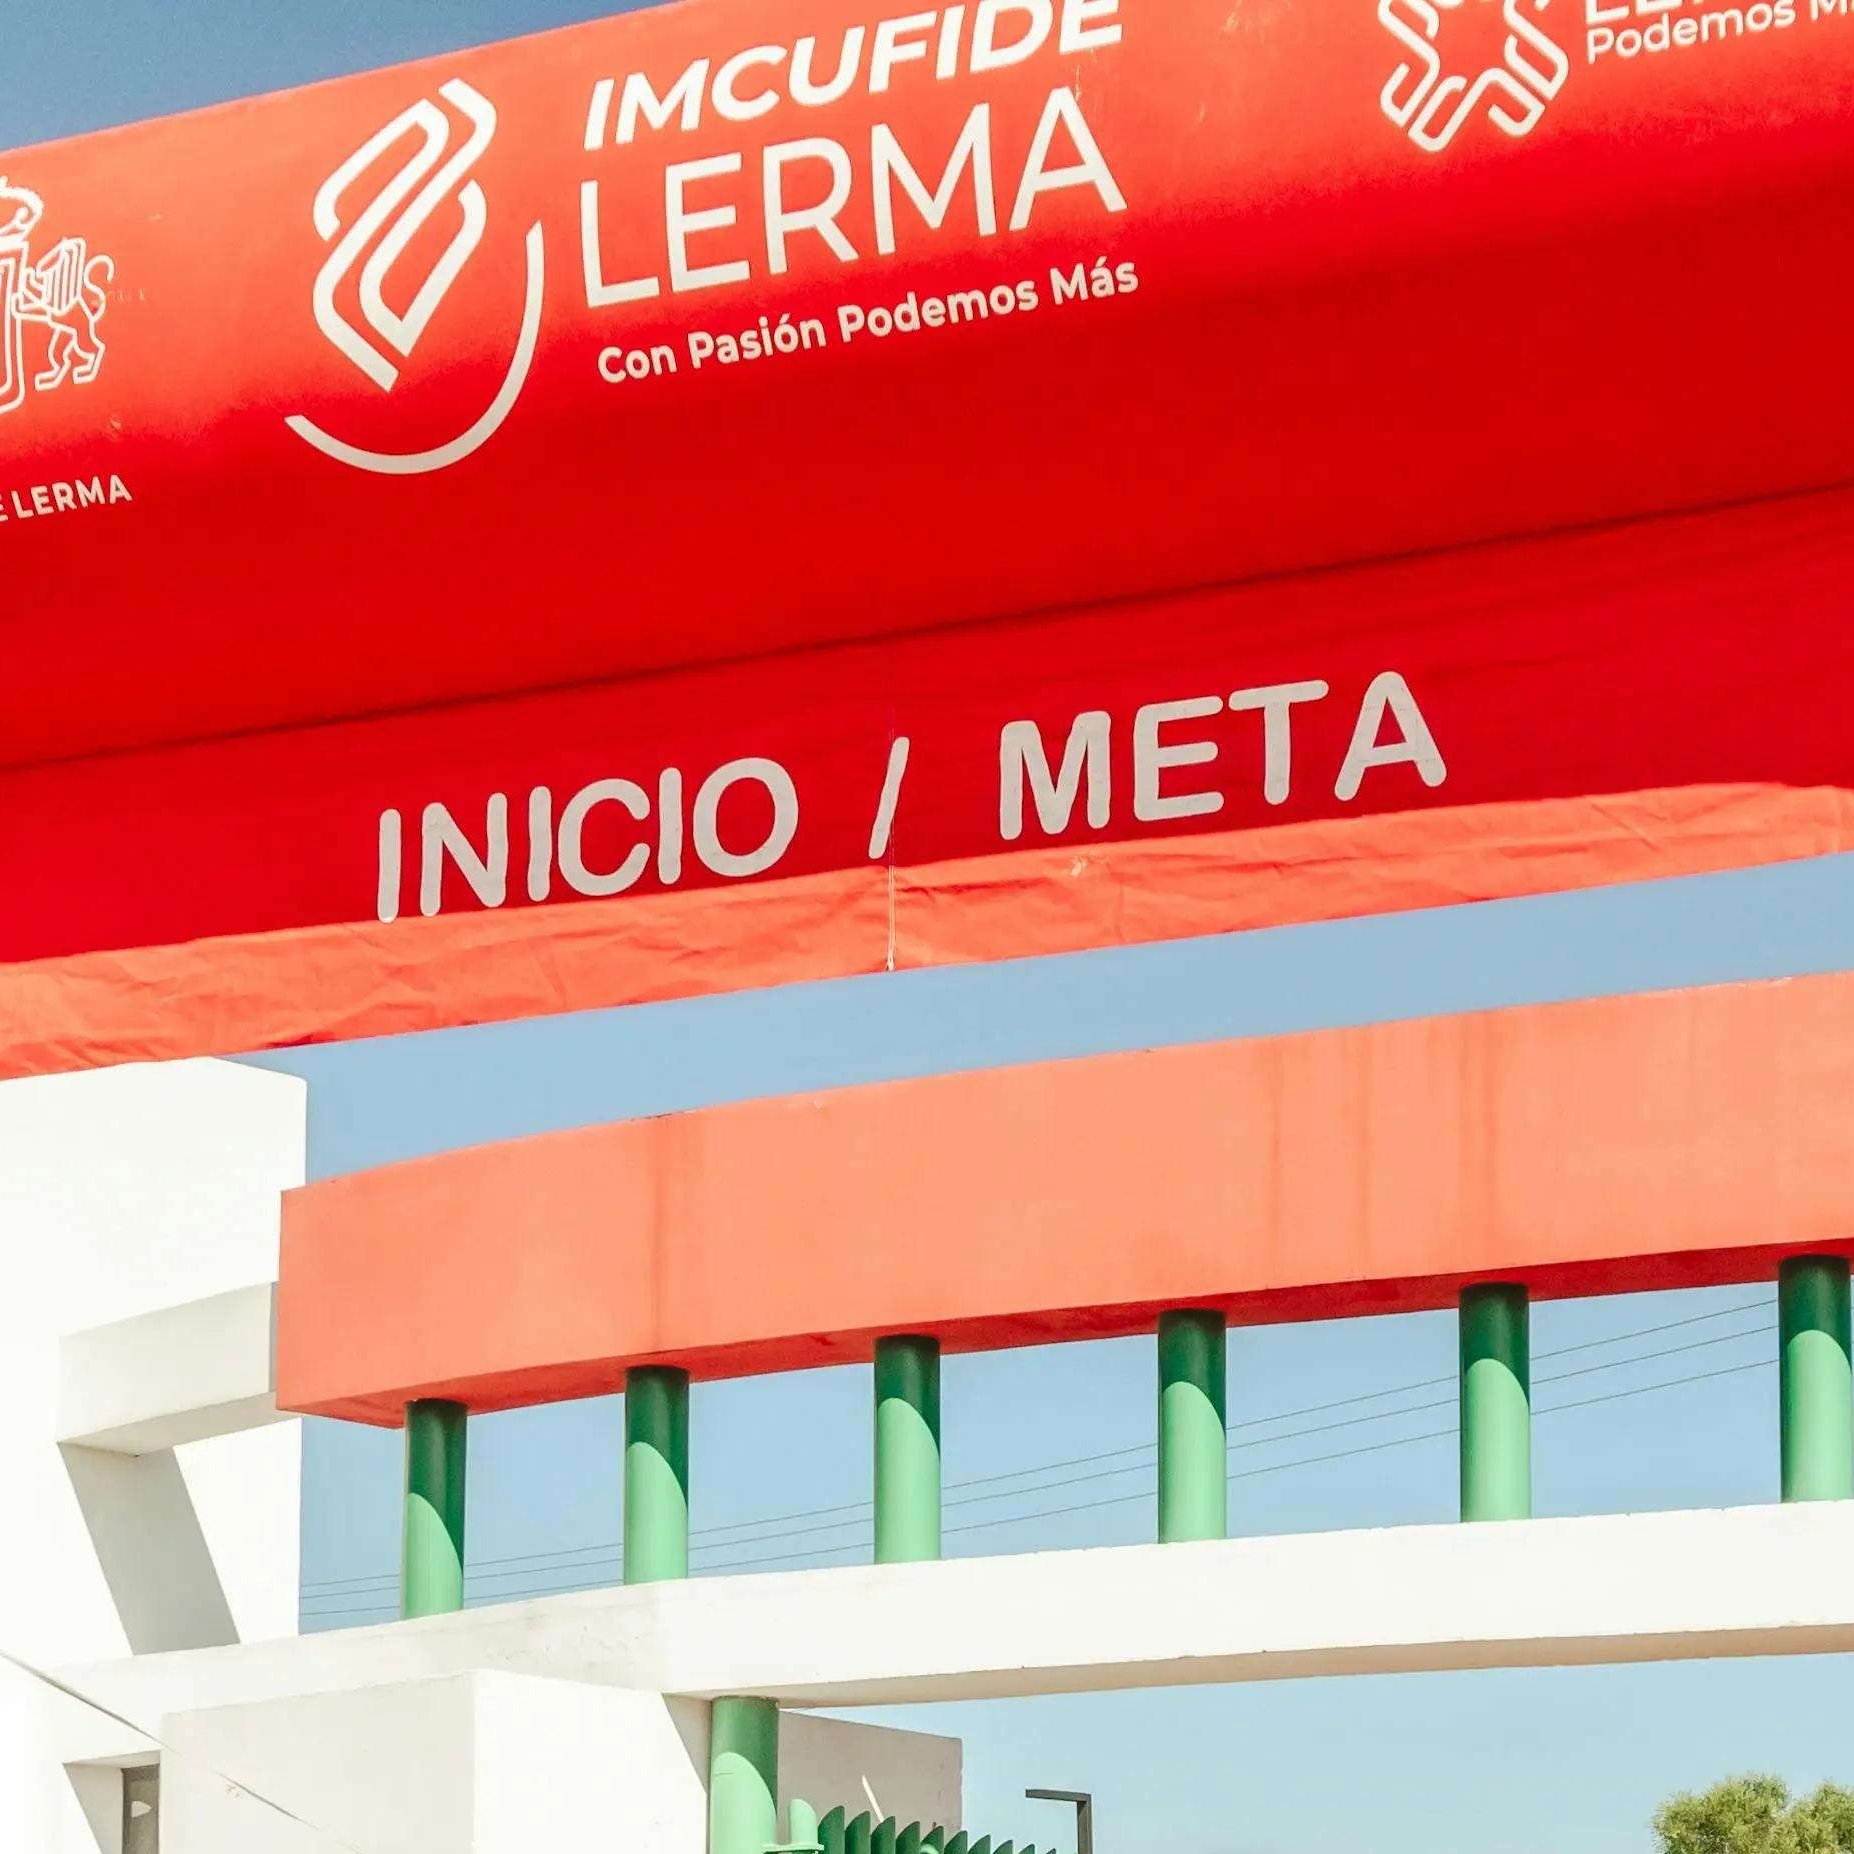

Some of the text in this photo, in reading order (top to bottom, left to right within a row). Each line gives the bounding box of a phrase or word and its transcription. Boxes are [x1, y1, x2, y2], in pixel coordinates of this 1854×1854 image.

[584, 0, 1125, 151] IMCUFIDE
[1585, 0, 1796, 64] Podemos
[580, 86, 1128, 308] LERMA
[597, 257, 1139, 384] Con Pasión Podemos Más
[11, 474, 133, 519] LERMA
[377, 757, 799, 923] INICIO
[999, 671, 1448, 840] META
